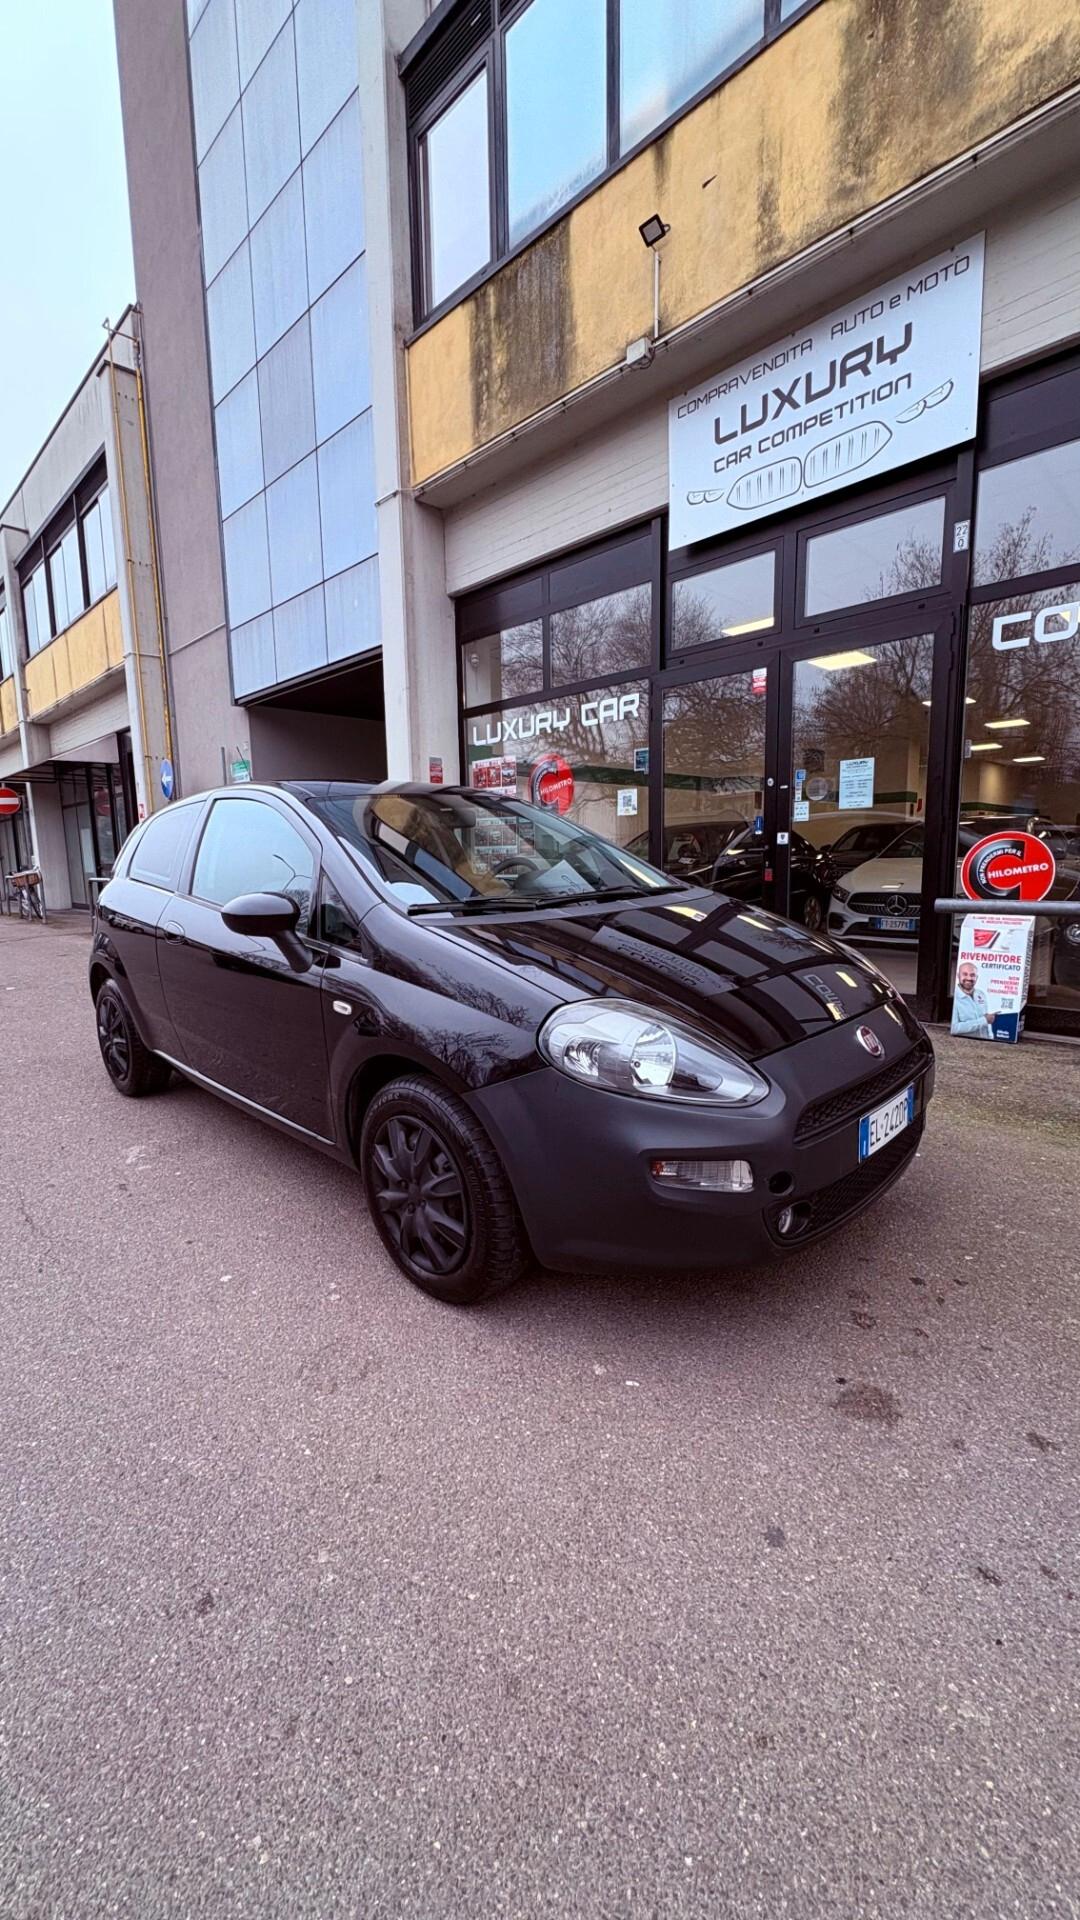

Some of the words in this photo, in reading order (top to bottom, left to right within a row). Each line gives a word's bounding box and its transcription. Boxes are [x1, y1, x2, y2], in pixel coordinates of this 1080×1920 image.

[677, 338, 814, 419] COMPRAVENDITA
[830, 300, 885, 340] AUTO
[889, 294, 901, 309] e
[906, 255, 970, 301] MOTO
[714, 321, 913, 445] LUXURY
[714, 445, 752, 474] CAR
[758, 372, 912, 454] COMPETITION
[472, 707, 571, 746] LUXURY
[580, 692, 640, 727] CAR
[960, 951, 1022, 964] RIVENDITORE
[981, 962, 1021, 971] CERTIFICATO
